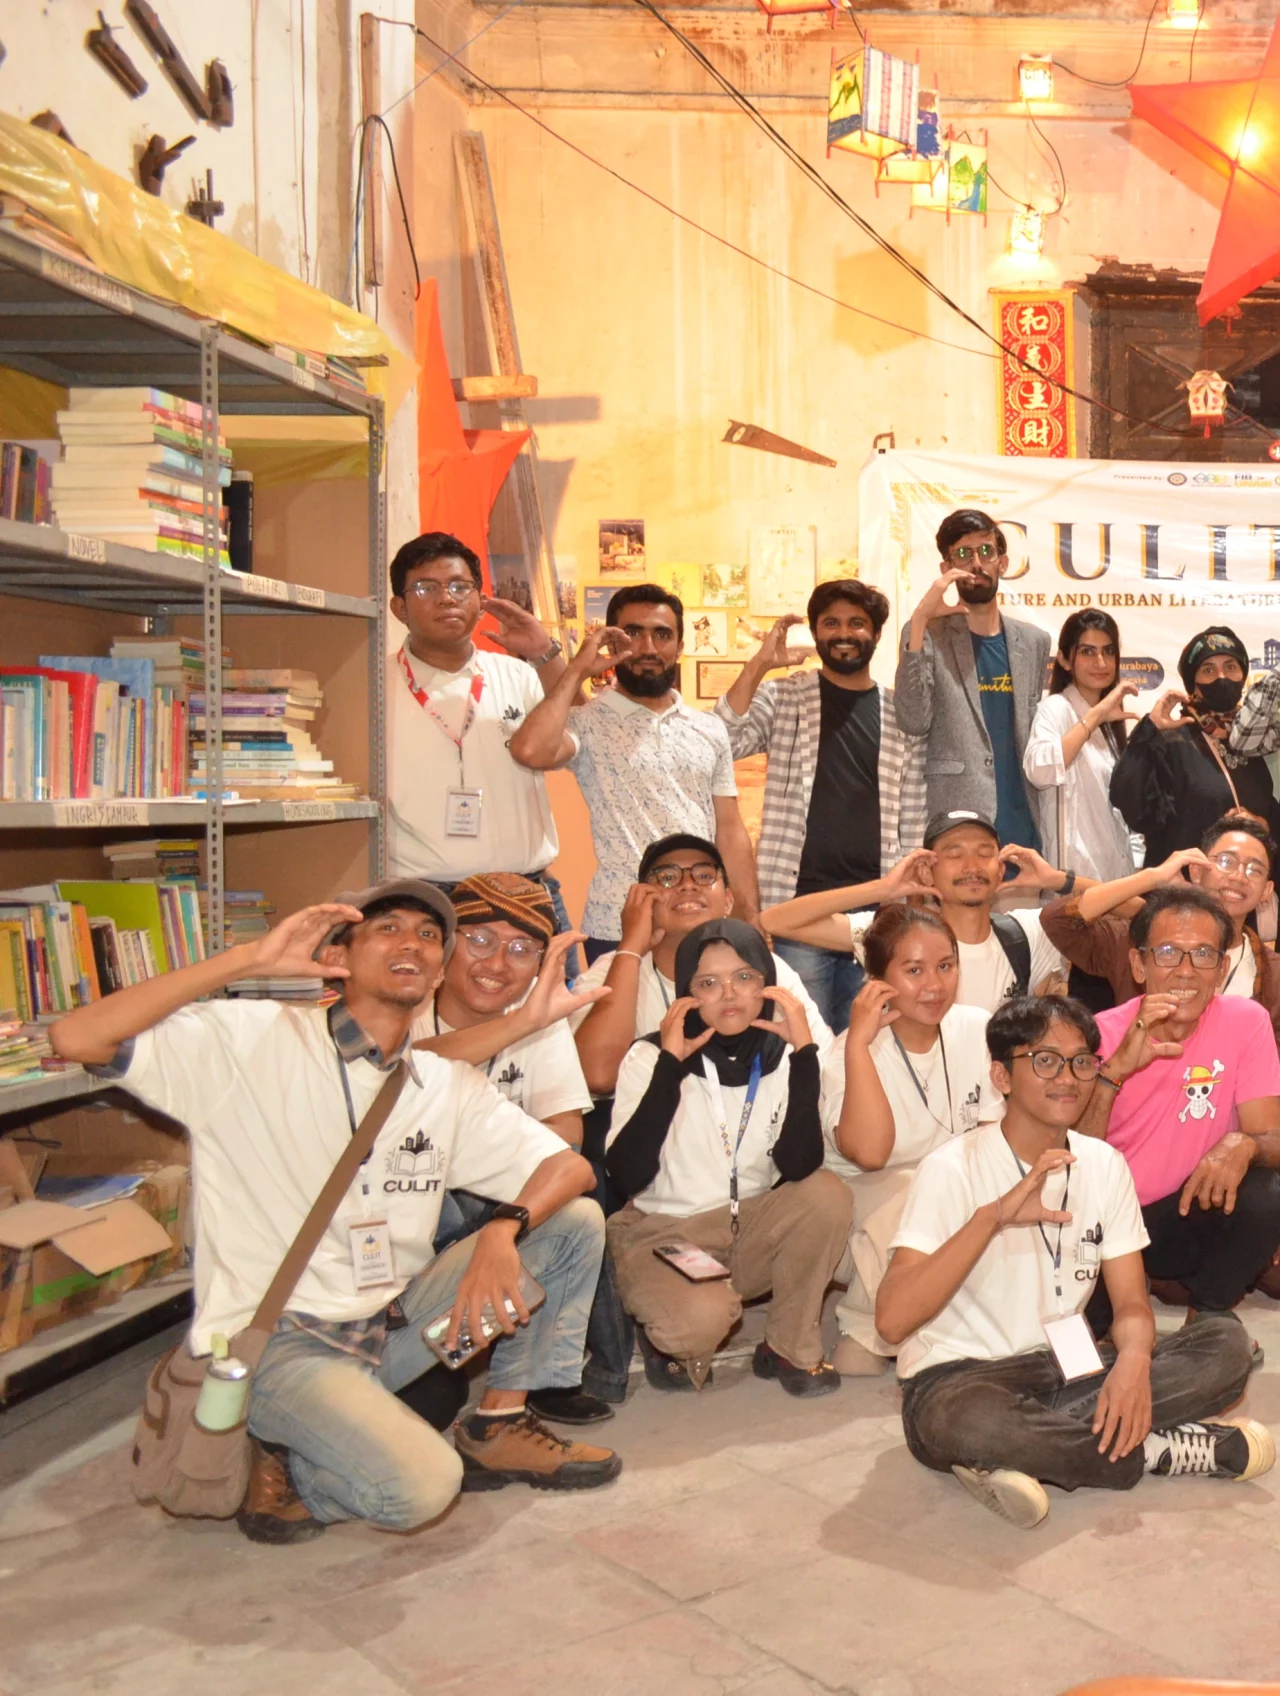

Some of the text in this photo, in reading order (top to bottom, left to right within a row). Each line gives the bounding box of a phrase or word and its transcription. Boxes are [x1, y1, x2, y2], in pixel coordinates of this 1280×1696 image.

[996, 592, 1046, 606] TURE
[1054, 593, 1093, 607] AND
[1098, 593, 1162, 607] URBAN
[1120, 661, 1158, 672] urabaya
[382, 1178, 442, 1194] CULIT
